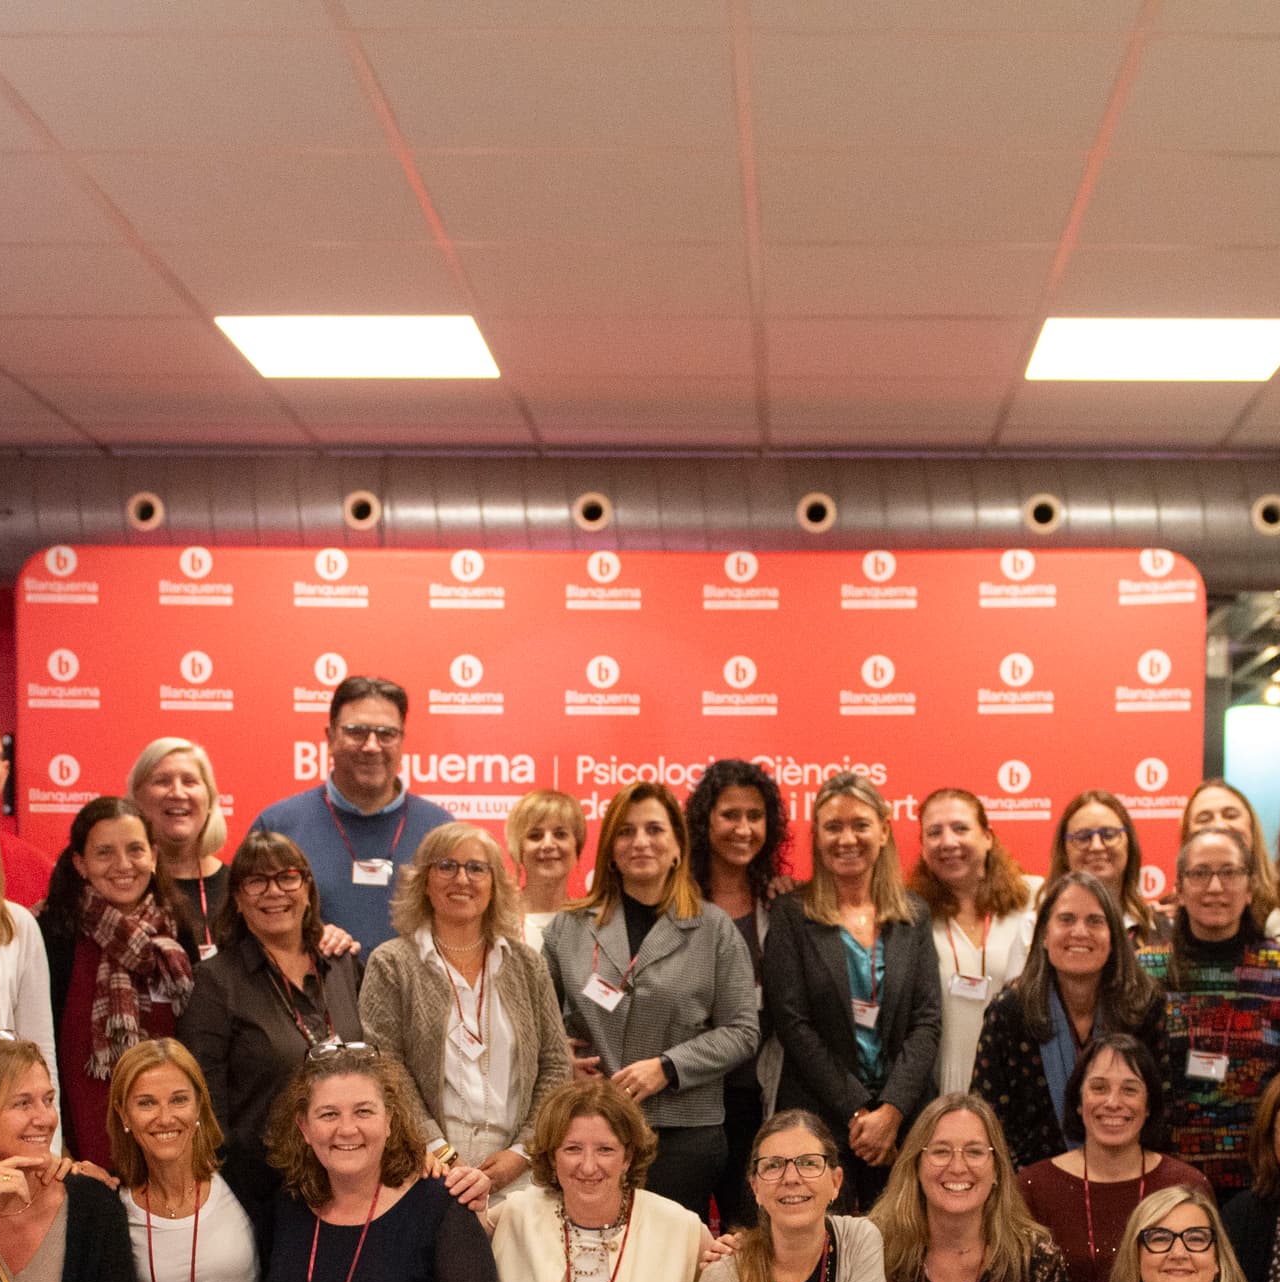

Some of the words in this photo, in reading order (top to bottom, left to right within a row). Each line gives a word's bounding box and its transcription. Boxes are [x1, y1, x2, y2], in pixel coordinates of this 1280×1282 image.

[27, 684, 101, 699] Blanquerna
[159, 685, 234, 700] Blanquerna
[293, 687, 334, 703] Blanq
[429, 689, 505, 704] Blanquerna
[564, 690, 641, 705] Blanquerna
[702, 691, 778, 705] Blanquerna
[839, 690, 917, 704] Blanquerna
[978, 688, 1055, 703] Blanquerna
[1116, 686, 1193, 700] Blanquerna
[293, 740, 536, 790] Bluerna
[476, 800, 513, 814] LLUL
